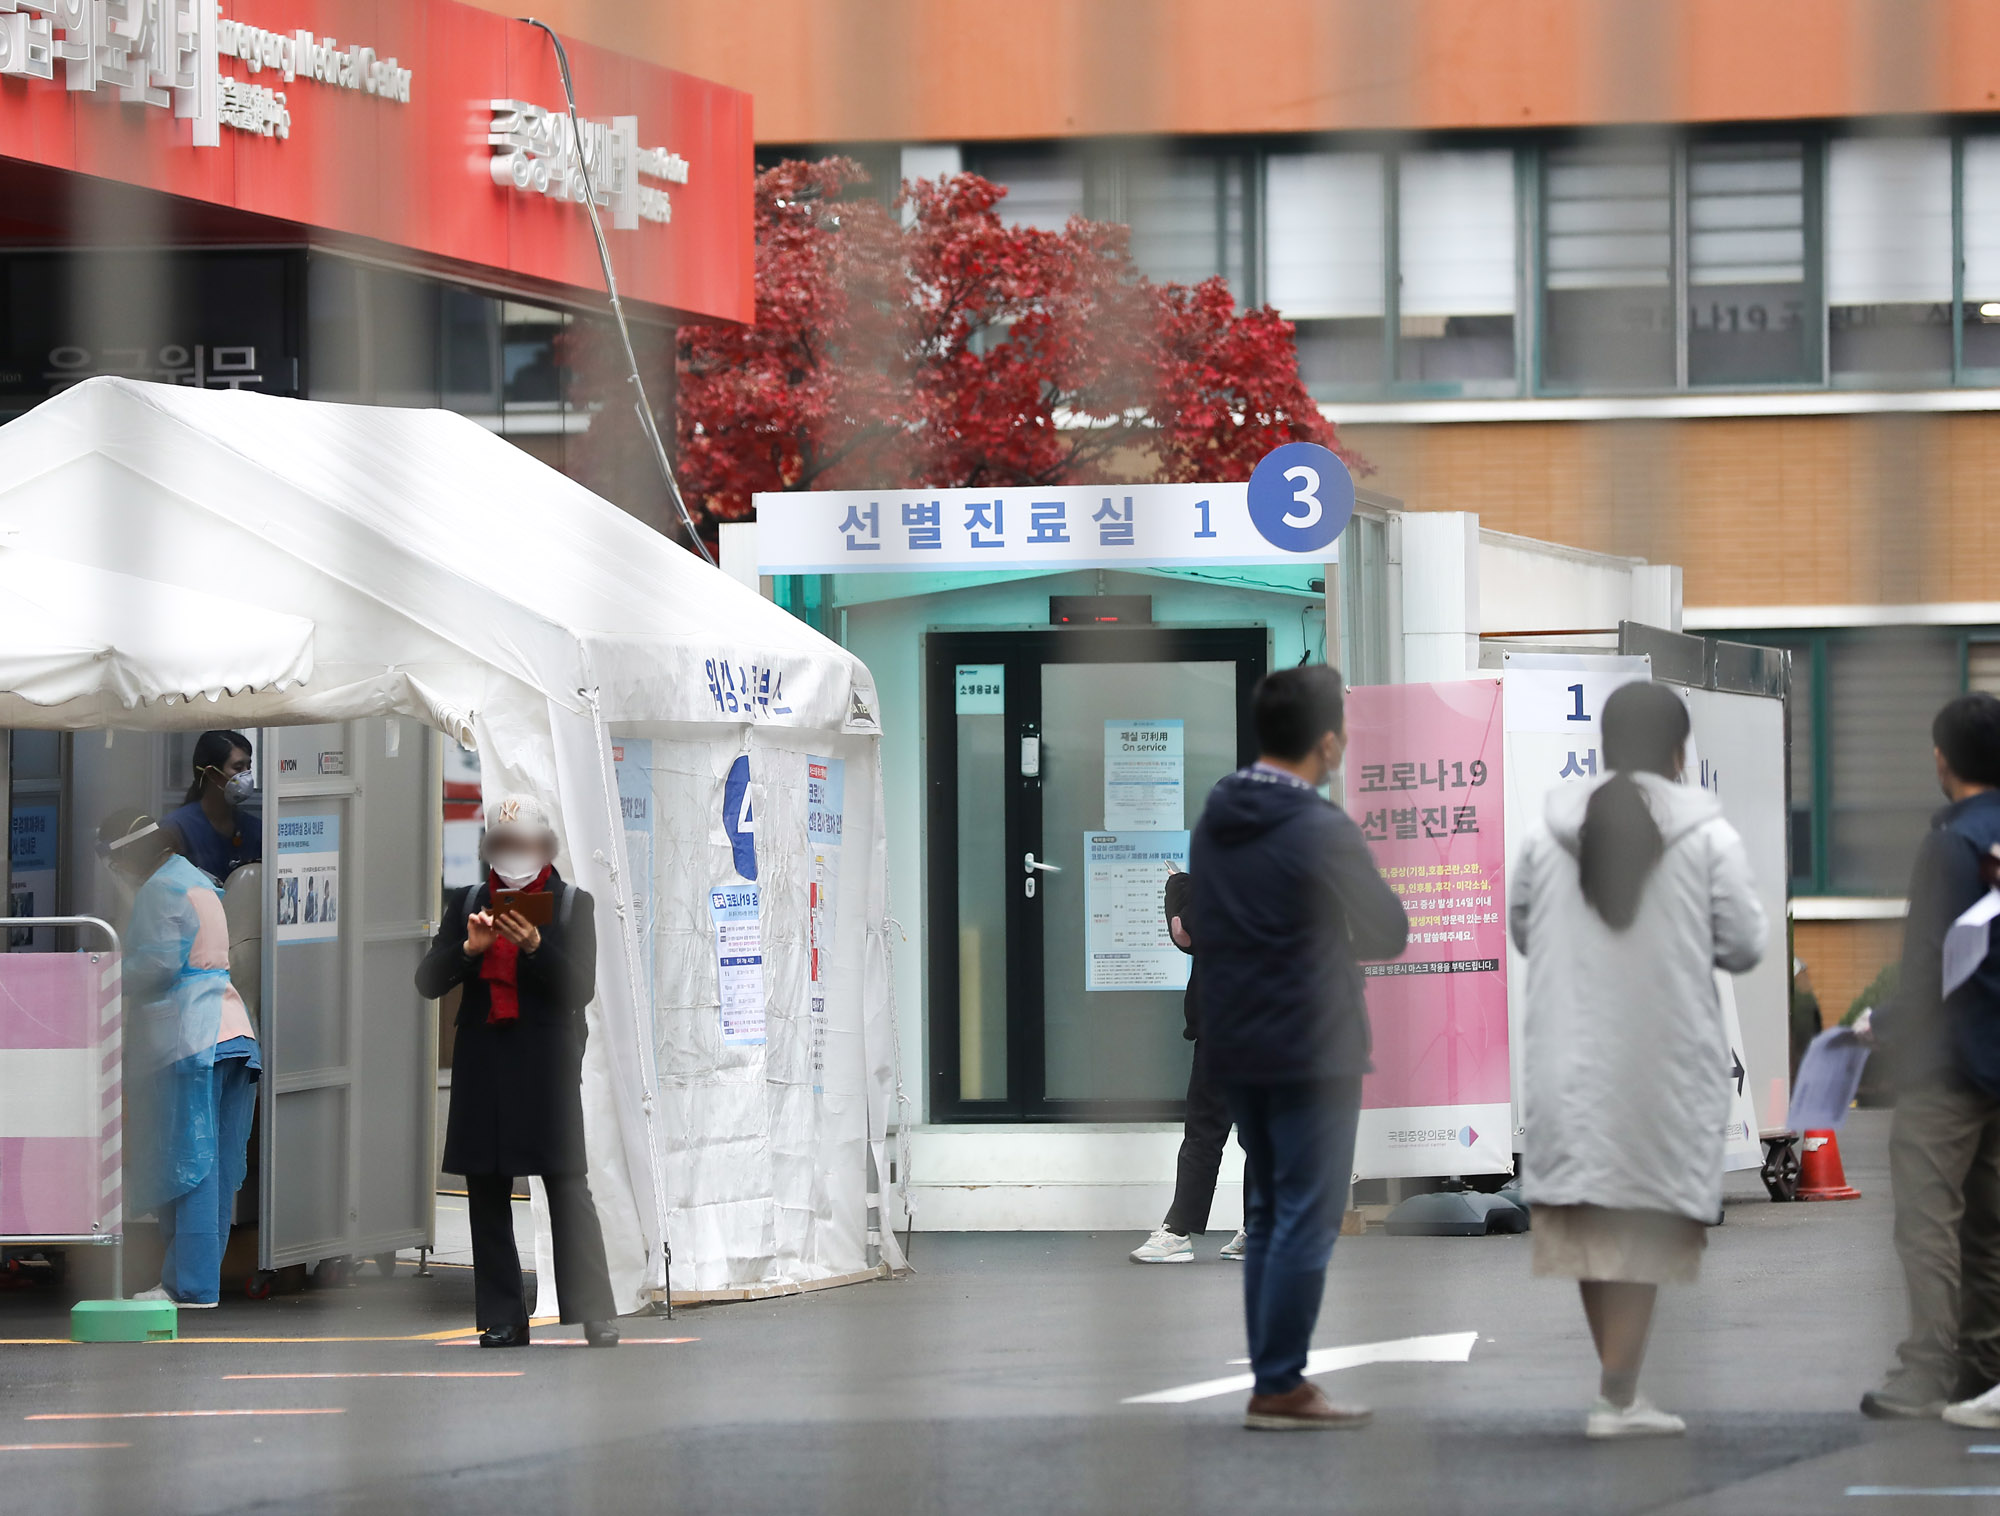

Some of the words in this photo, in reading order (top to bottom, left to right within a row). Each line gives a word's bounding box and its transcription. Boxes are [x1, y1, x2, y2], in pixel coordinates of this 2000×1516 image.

[217, 5, 296, 83] mergency
[295, 29, 360, 89] Medical
[358, 46, 412, 104] Center
[1281, 465, 1323, 529] 3
[838, 496, 1135, 551] 선별진료실
[1194, 500, 1217, 538] 1
[1566, 683, 1592, 721] 1
[1120, 731, 1138, 742] 재실
[1141, 731, 1168, 742] 可利用
[1122, 743, 1135, 752] On
[1137, 743, 1167, 752] service
[1359, 759, 1488, 792] 코로나19
[1360, 805, 1479, 841] 선별진료
[1420, 899, 1436, 910] 증상
[1438, 898, 1454, 909] 발생
[1456, 897, 1474, 908] 14일
[1475, 896, 1492, 907] 이내
[1408, 915, 1441, 927] 발생지역
[1466, 914, 1482, 924] 있는
[1483, 912, 1499, 924] 분은
[1423, 931, 1474, 943] 말씀해주세요.
[1364, 965, 1385, 976] 의료원
[1386, 964, 1407, 975] 방문시
[1408, 963, 1429, 974] 마스크
[1430, 962, 1450, 973] 착용을
[1451, 960, 1494, 972] 부탁드립니다.
[1388, 1128, 1457, 1142] 국립중앙의료원
